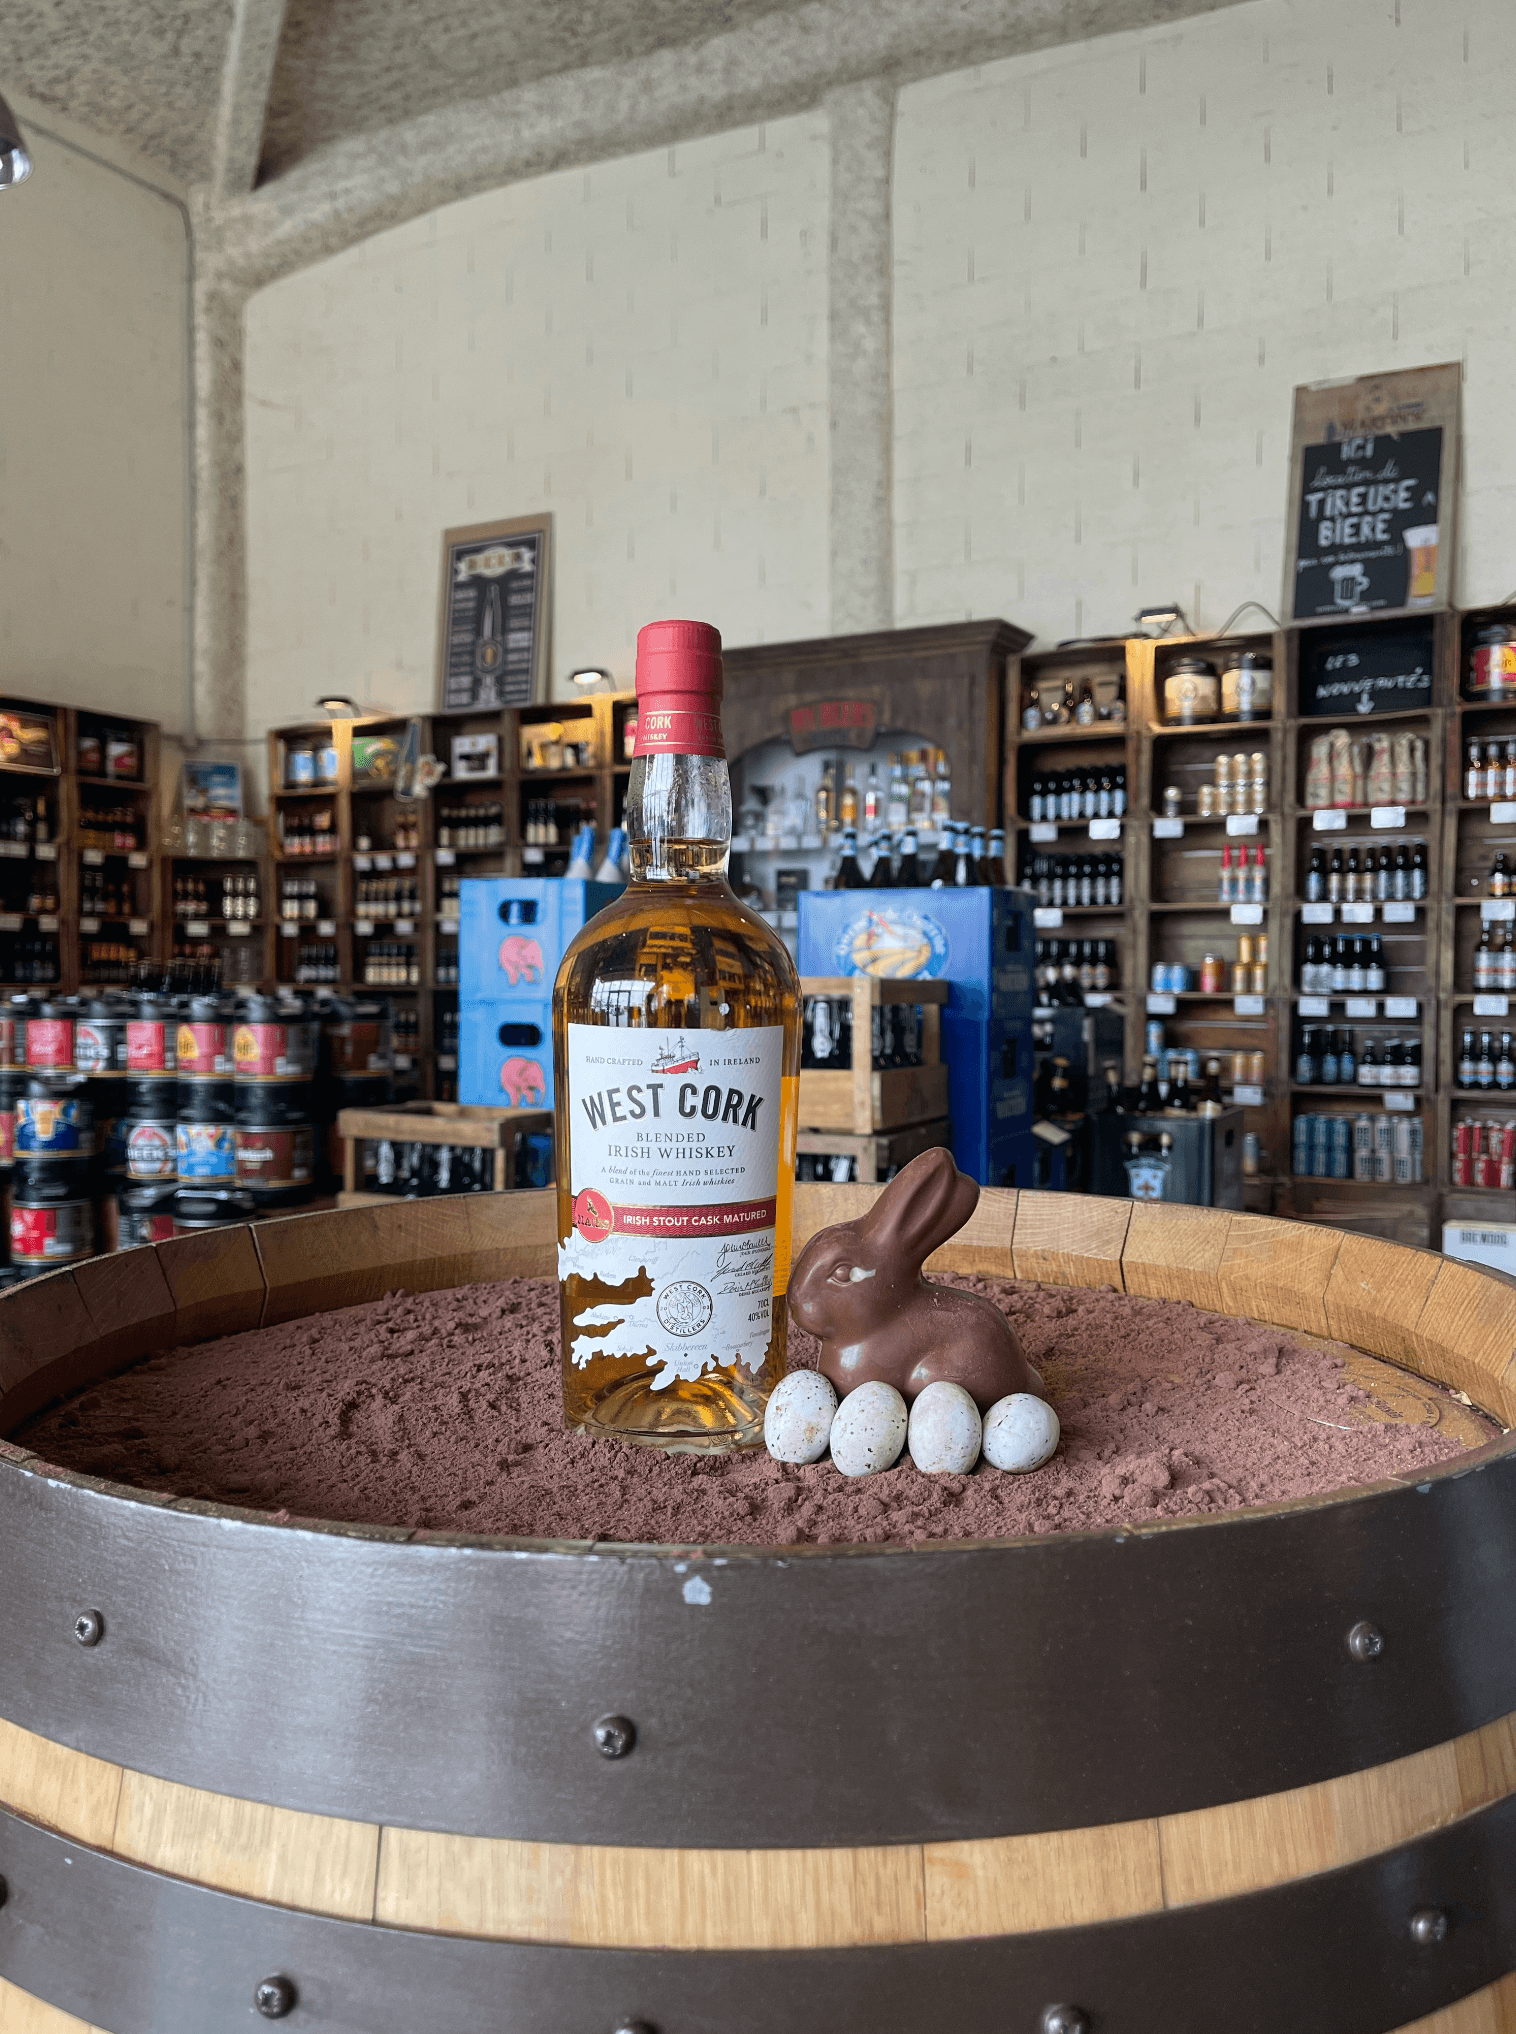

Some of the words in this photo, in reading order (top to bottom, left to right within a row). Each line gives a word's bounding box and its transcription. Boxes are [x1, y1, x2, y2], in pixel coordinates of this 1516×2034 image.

[1325, 652, 1360, 671] LES
[645, 716, 671, 729] CORK
[586, 1056, 605, 1064] HAND
[607, 1058, 643, 1066] CRAFTED
[723, 1057, 761, 1066] IRELAND
[581, 1083, 665, 1132] WEST
[678, 1083, 765, 1132] CORK
[636, 1132, 706, 1143] BLENDED
[608, 1144, 651, 1159] IRISH
[658, 1145, 736, 1159] WHISKEY
[608, 1165, 628, 1175] blend
[650, 1168, 674, 1178] finest
[676, 1169, 701, 1177] HAND
[704, 1166, 746, 1176] SELECTED
[609, 1177, 635, 1186] GRAIN
[681, 1178, 701, 1187] Irish
[702, 1177, 735, 1186] whiskies
[623, 1215, 649, 1225] IRISH
[652, 1216, 689, 1226] STOUT
[691, 1215, 720, 1226] CASK
[723, 1209, 767, 1224] MATURED
[663, 1284, 682, 1300] WEST
[687, 1284, 707, 1300] CORK
[663, 1318, 706, 1334] DISTILLERS
[664, 1342, 708, 1352] Skibbereen
